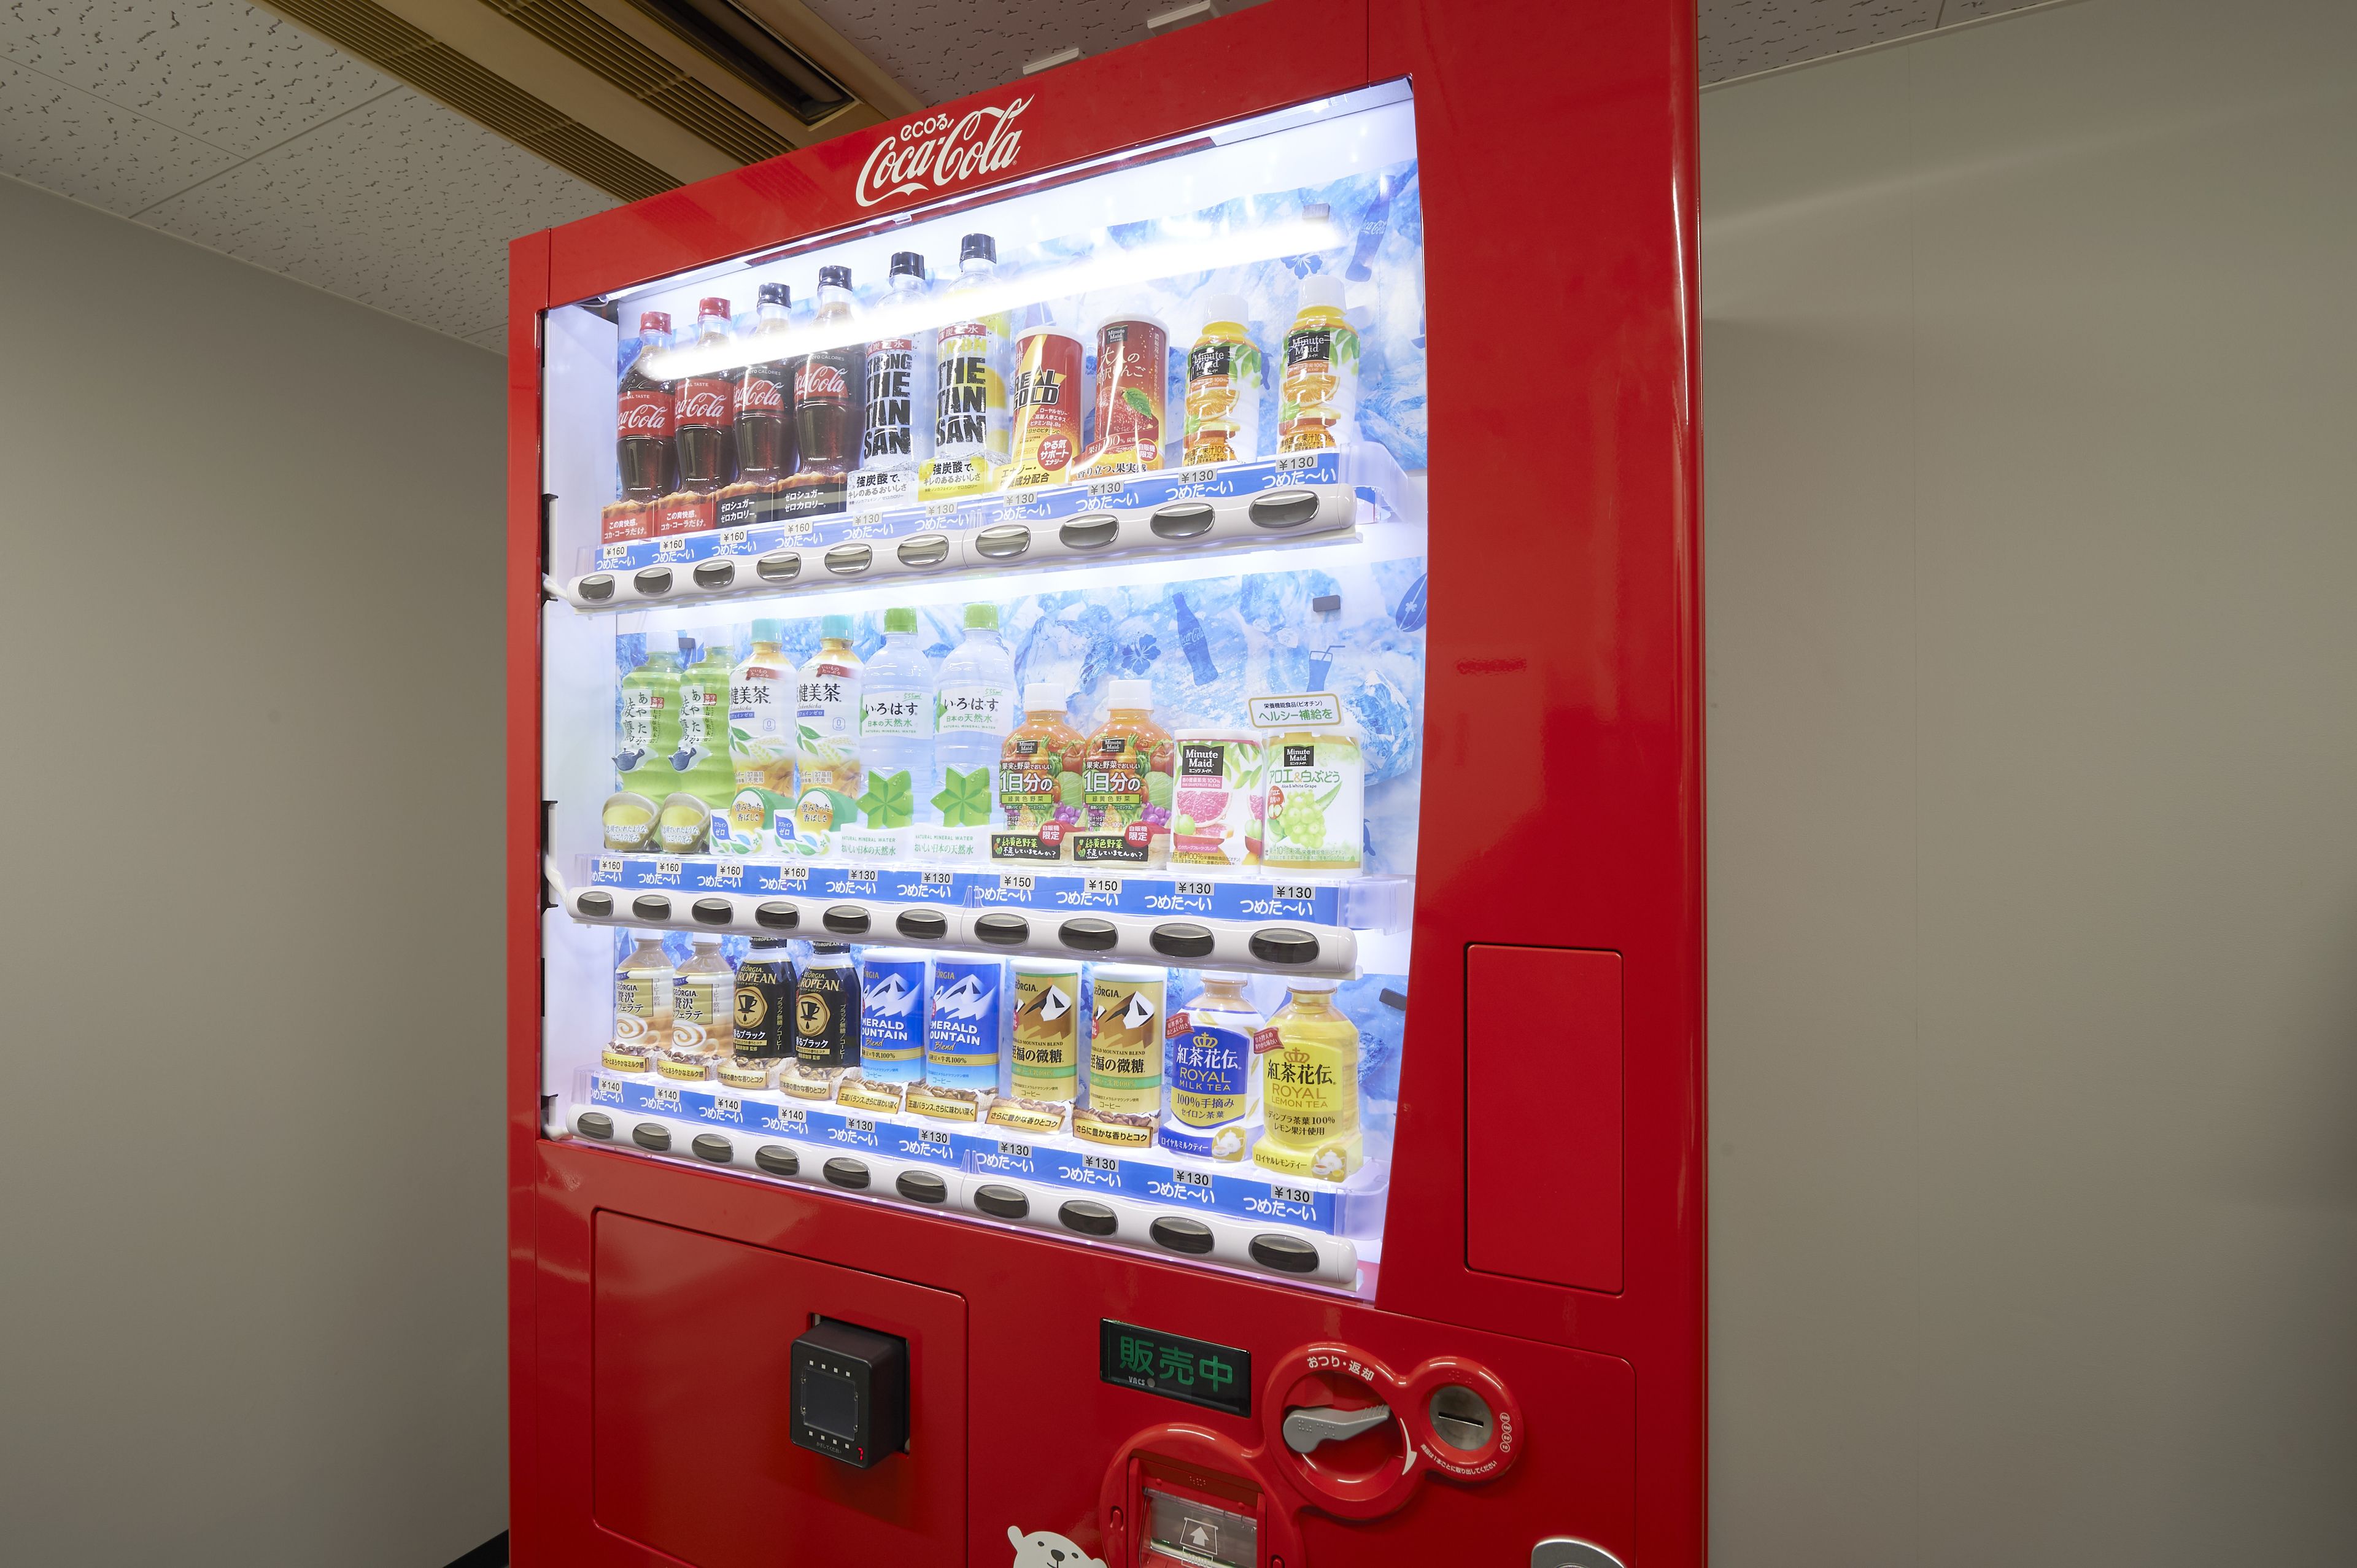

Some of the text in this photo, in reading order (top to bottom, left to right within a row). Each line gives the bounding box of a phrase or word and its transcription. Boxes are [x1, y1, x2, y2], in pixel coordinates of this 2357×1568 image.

[900, 114, 954, 141] ecoる
[856, 93, 1035, 207] Coca-Cola
[936, 415, 985, 447] SAN
[864, 427, 910, 460] SAN
[1043, 439, 1067, 450] やる気
[1040, 449, 1069, 460] サポート
[1279, 457, 1314, 469] ¥130
[923, 473, 981, 487] キレのあるおいしさ
[1181, 469, 1213, 483] ¥130
[848, 484, 907, 498] キレのあるおいしさ
[1091, 482, 1121, 495] ¥130
[786, 489, 824, 501] ゼロシュガー
[1007, 493, 1034, 506] ¥130
[721, 499, 755, 512] ゼロシュガー
[785, 500, 826, 512] ゼロカロリー。
[928, 504, 954, 515] ¥130
[667, 510, 697, 520] この爽快感。
[721, 511, 757, 523] ゼロカロリー。
[856, 514, 880, 525] ¥130
[788, 523, 810, 533] ¥160
[724, 531, 744, 542] ¥160
[664, 539, 683, 549] ¥160
[606, 546, 625, 556] ¥160
[636, 692, 648, 745] あやたか
[689, 689, 700, 744] あやたか
[946, 713, 993, 722] 日本の天然水
[1259, 709, 1333, 722] ヘルシー補給を
[867, 719, 913, 727] 日本の天然水
[1186, 749, 1218, 759] Minute
[1002, 762, 1052, 770] 果実と野菜でおいしい
[1086, 761, 1140, 770] 果実と野菜でおいしい
[1188, 759, 1212, 767] Maid
[1000, 772, 1053, 792] 1日分の
[1083, 772, 1140, 792] 1日分の
[1269, 769, 1340, 784] アロエ&白ぶどう
[735, 803, 761, 812] 澄みきった
[801, 803, 829, 812] 澄みきった
[804, 814, 827, 822] 香ばしさ
[1042, 832, 1059, 840] 限定
[1128, 832, 1147, 841] 限定
[842, 844, 896, 856] おいしい日本の天然水
[915, 843, 973, 855] おいしい日本の天然水
[602, 861, 621, 870] ¥160
[660, 863, 679, 872] ¥160
[720, 866, 740, 875] ¥160
[784, 868, 806, 878] ¥160
[851, 871, 875, 880] ¥130
[924, 873, 950, 883] ¥130
[1004, 876, 1031, 887] ¥150
[1089, 879, 1117, 891] ¥150
[1178, 882, 1211, 894] ¥130
[1277, 886, 1311, 898] ¥130
[865, 1038, 884, 1048] Blend
[934, 1041, 956, 1051] Blend
[1012, 1045, 1062, 1064] 至福の微糖
[1102, 1047, 1128, 1056] MOUNTAIN
[1176, 1044, 1238, 1070] 紅茶花伝
[1091, 1054, 1145, 1073] 至福の微糖
[1179, 1067, 1231, 1083] ROYAL
[1267, 1059, 1333, 1085] 紅茶花伝
[602, 1080, 620, 1091] ¥140
[1179, 1080, 1202, 1091] MILK
[1272, 1083, 1326, 1100] ROYAL
[658, 1089, 677, 1100] ¥140
[1177, 1093, 1234, 1108] 100%手摘み
[718, 1099, 738, 1110] ¥140
[840, 1093, 897, 1110] 王道バランス、さらに味わい深く
[1271, 1097, 1302, 1108] LEMON
[908, 1100, 974, 1116] 王道バランス、さらに味わい深く
[1182, 1108, 1225, 1119] セイロン茶葉
[781, 1109, 803, 1121] ¥140
[991, 1111, 1058, 1128] さらに豊かな香りとコク
[848, 1119, 873, 1131] ¥130
[1274, 1123, 1325, 1135] レモン果汁使用
[921, 1130, 947, 1143] ¥130
[1076, 1124, 1148, 1142] さらに豊かな香りとコク
[1001, 1143, 1029, 1156] ¥130
[1161, 1137, 1209, 1153] ロイヤルミルクティー
[1085, 1156, 1115, 1170] ¥130
[1256, 1153, 1307, 1168] ロイヤルレモンティー
[1177, 1171, 1209, 1186] ¥130
[1275, 1186, 1309, 1202] ¥130
[1120, 1335, 1233, 1392] 販売中
[1307, 1354, 1375, 1382] おつり・返却
